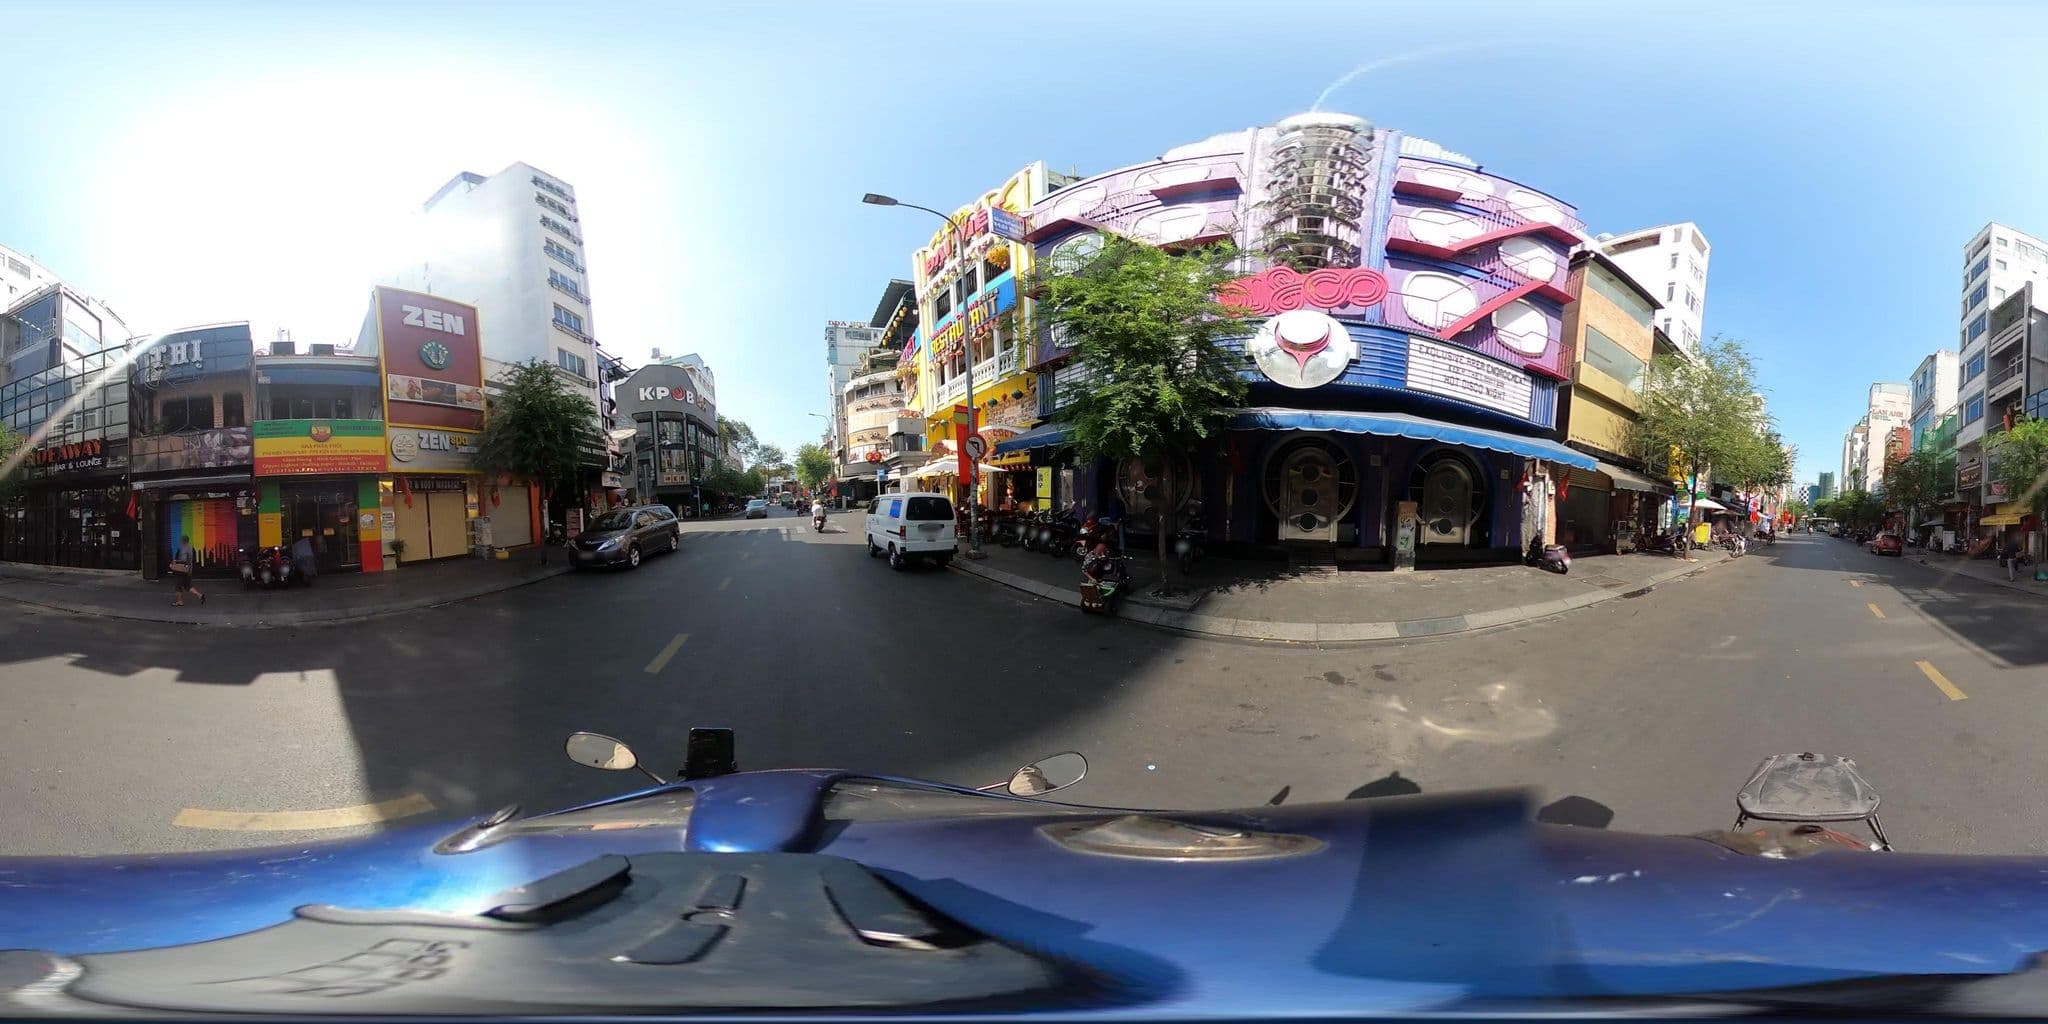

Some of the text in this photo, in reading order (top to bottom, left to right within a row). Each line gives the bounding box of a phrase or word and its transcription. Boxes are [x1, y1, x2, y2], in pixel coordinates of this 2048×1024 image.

[402, 304, 465, 336] ZEN
[931, 297, 998, 355] RESTAUANT
[418, 432, 450, 451] ZEN
[76, 457, 103, 469] LOUNGE
